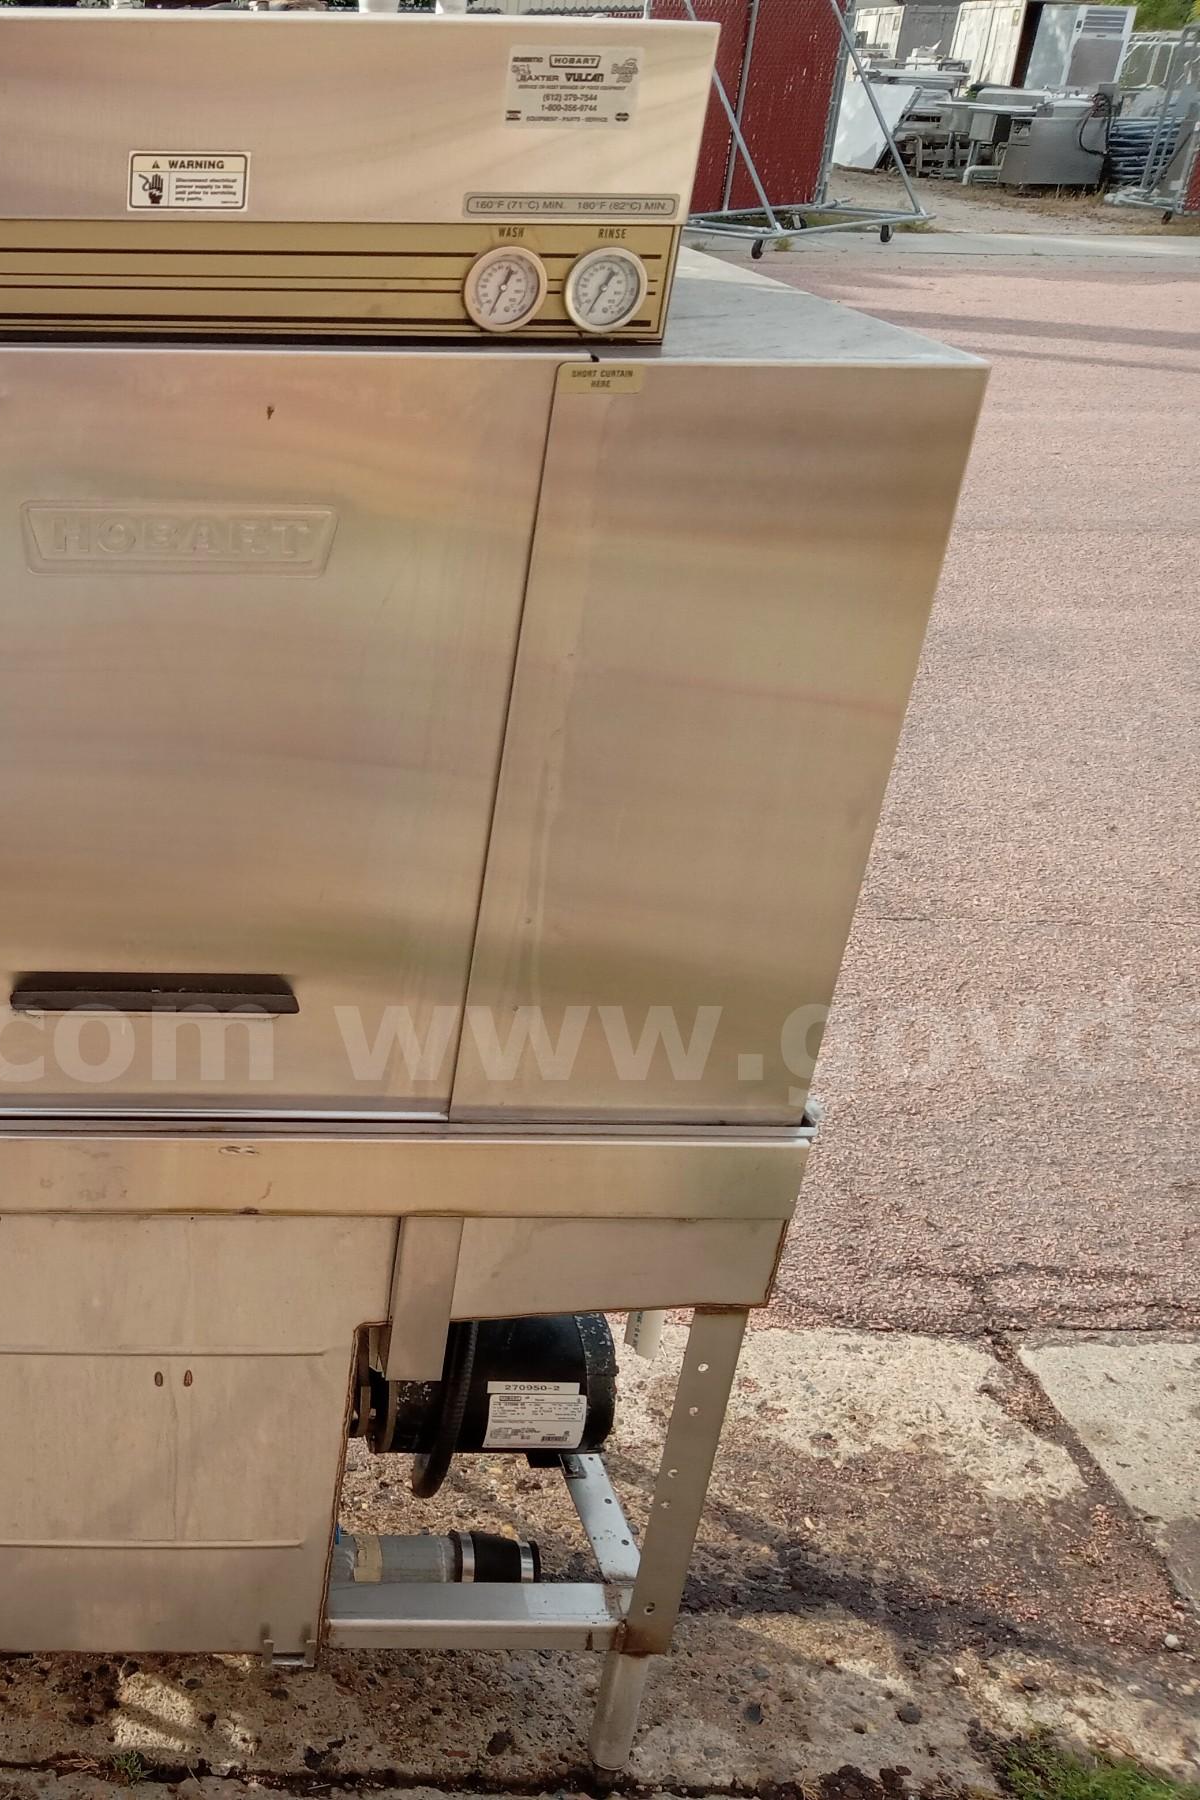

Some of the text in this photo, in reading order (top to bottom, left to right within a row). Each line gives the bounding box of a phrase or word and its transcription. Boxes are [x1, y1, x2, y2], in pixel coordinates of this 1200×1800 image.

[553, 57, 597, 65] HOBART
[565, 73, 604, 82] VULCAN
[168, 160, 225, 169] WARNING
[498, 227, 525, 238] WASH
[598, 228, 627, 239] RINSE
[571, 370, 634, 378] SHORT CURTAIN
[590, 380, 611, 388] HERE
[50, 516, 312, 555] HOBART
